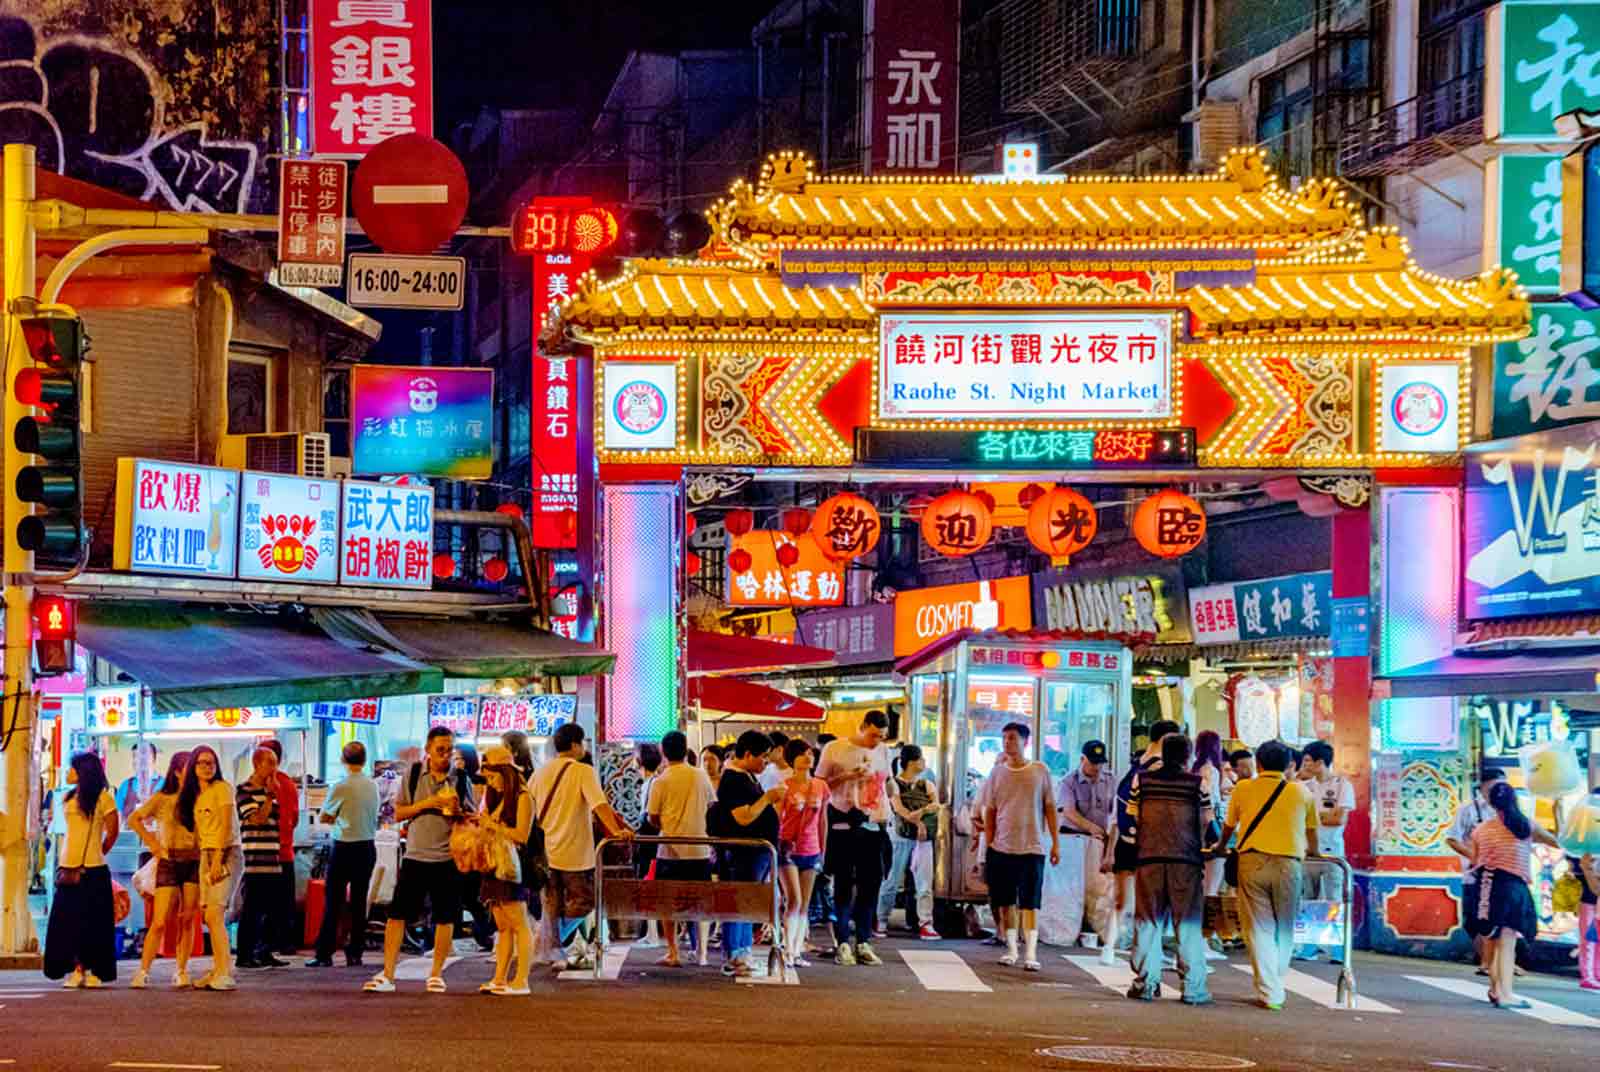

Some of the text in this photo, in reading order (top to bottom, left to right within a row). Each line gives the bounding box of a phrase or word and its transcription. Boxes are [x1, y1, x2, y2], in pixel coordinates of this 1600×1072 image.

[887, 49, 942, 168] 永和
[288, 165, 311, 256] 禁止停車
[316, 167, 338, 256] 徒步區內
[282, 266, 340, 284] 16:00-24:00
[354, 268, 458, 294] 16:00~24:00
[894, 334, 1157, 365] 饒河街觀光夜市
[892, 383, 1161, 404] Raohe St. Night Market
[347, 488, 430, 533] 武大郎
[935, 512, 979, 548] 迎
[1051, 503, 1091, 544] 光
[1158, 507, 1201, 545] 臨
[135, 525, 205, 565] 飲料吧
[345, 534, 429, 581] 胡椒餅
